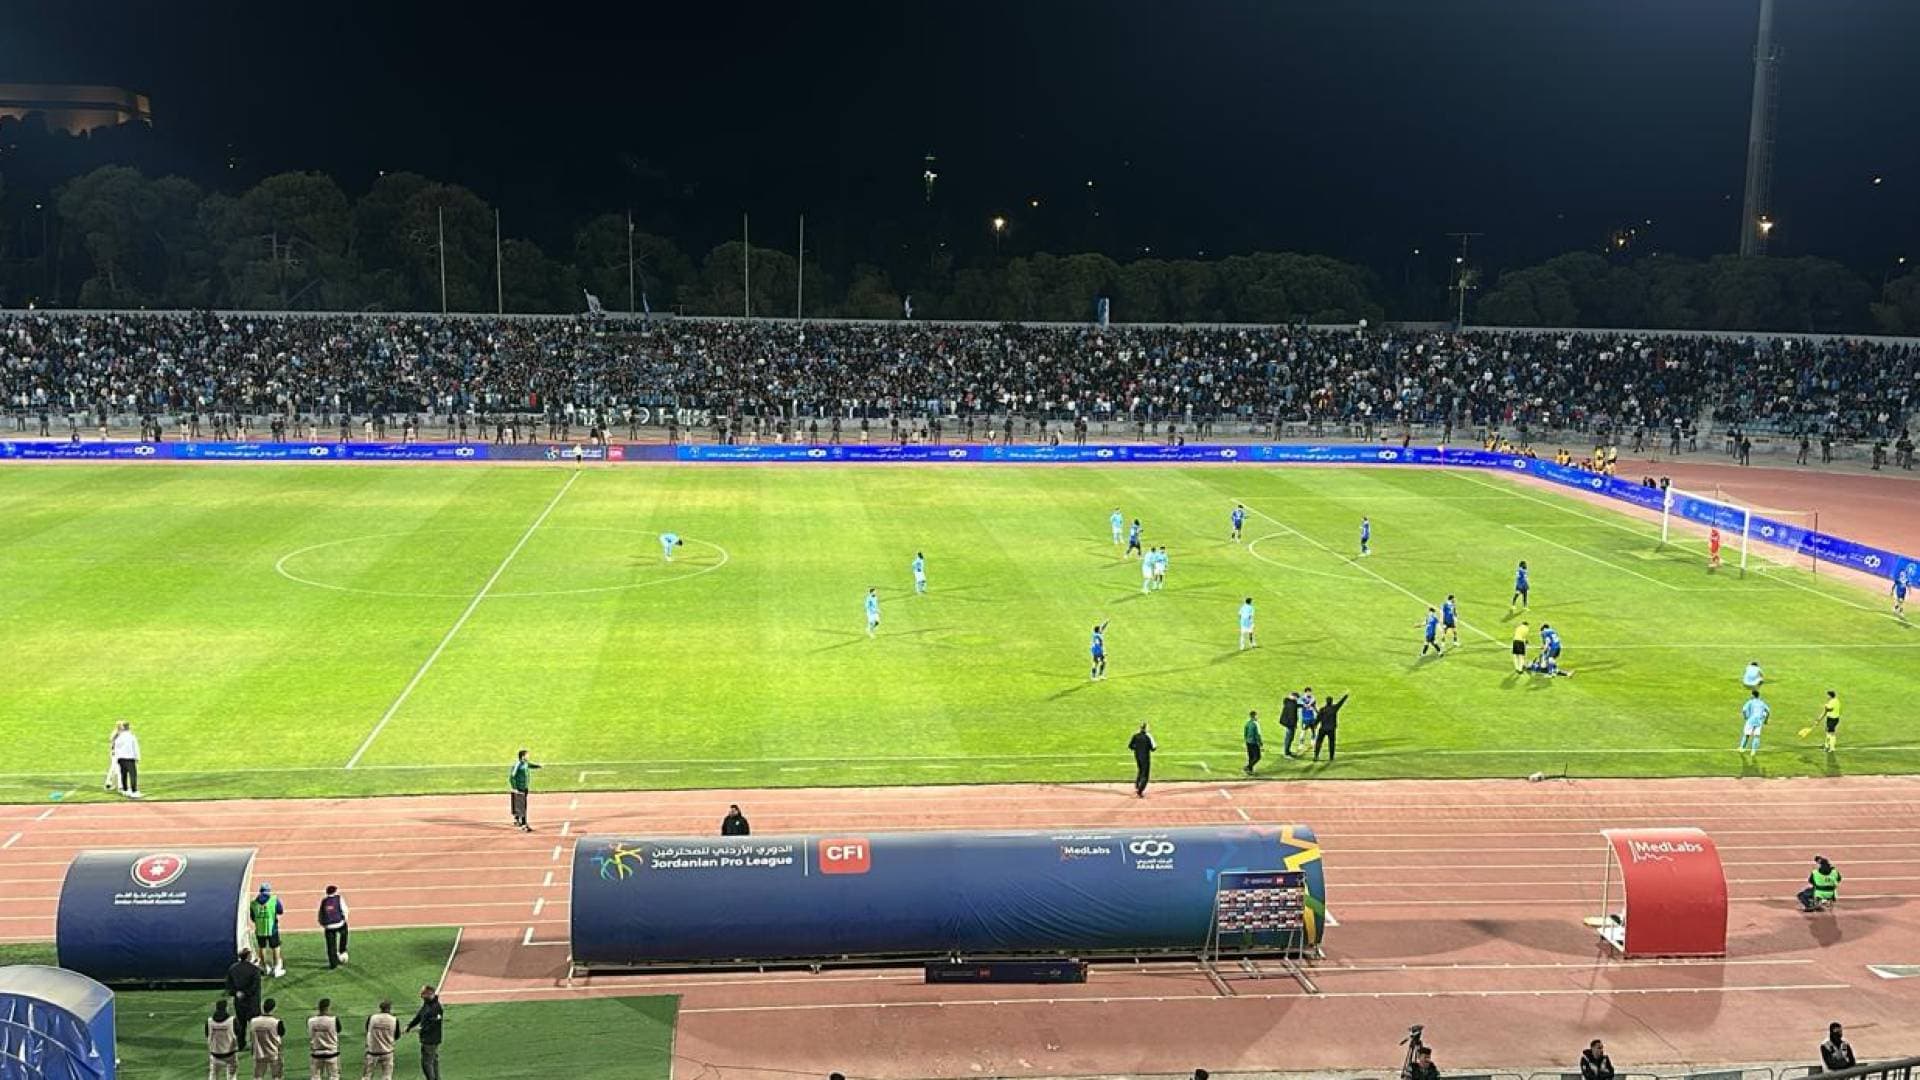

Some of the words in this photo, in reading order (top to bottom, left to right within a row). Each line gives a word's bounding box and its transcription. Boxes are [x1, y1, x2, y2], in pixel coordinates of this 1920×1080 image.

[756, 845, 793, 856] الدوري
[827, 845, 863, 861] CFI
[1063, 846, 1111, 854] MedLabs
[1635, 840, 1704, 853] MedLabs
[651, 858, 717, 869] Jordanian
[720, 857, 744, 867] Pro
[746, 856, 793, 868] League
